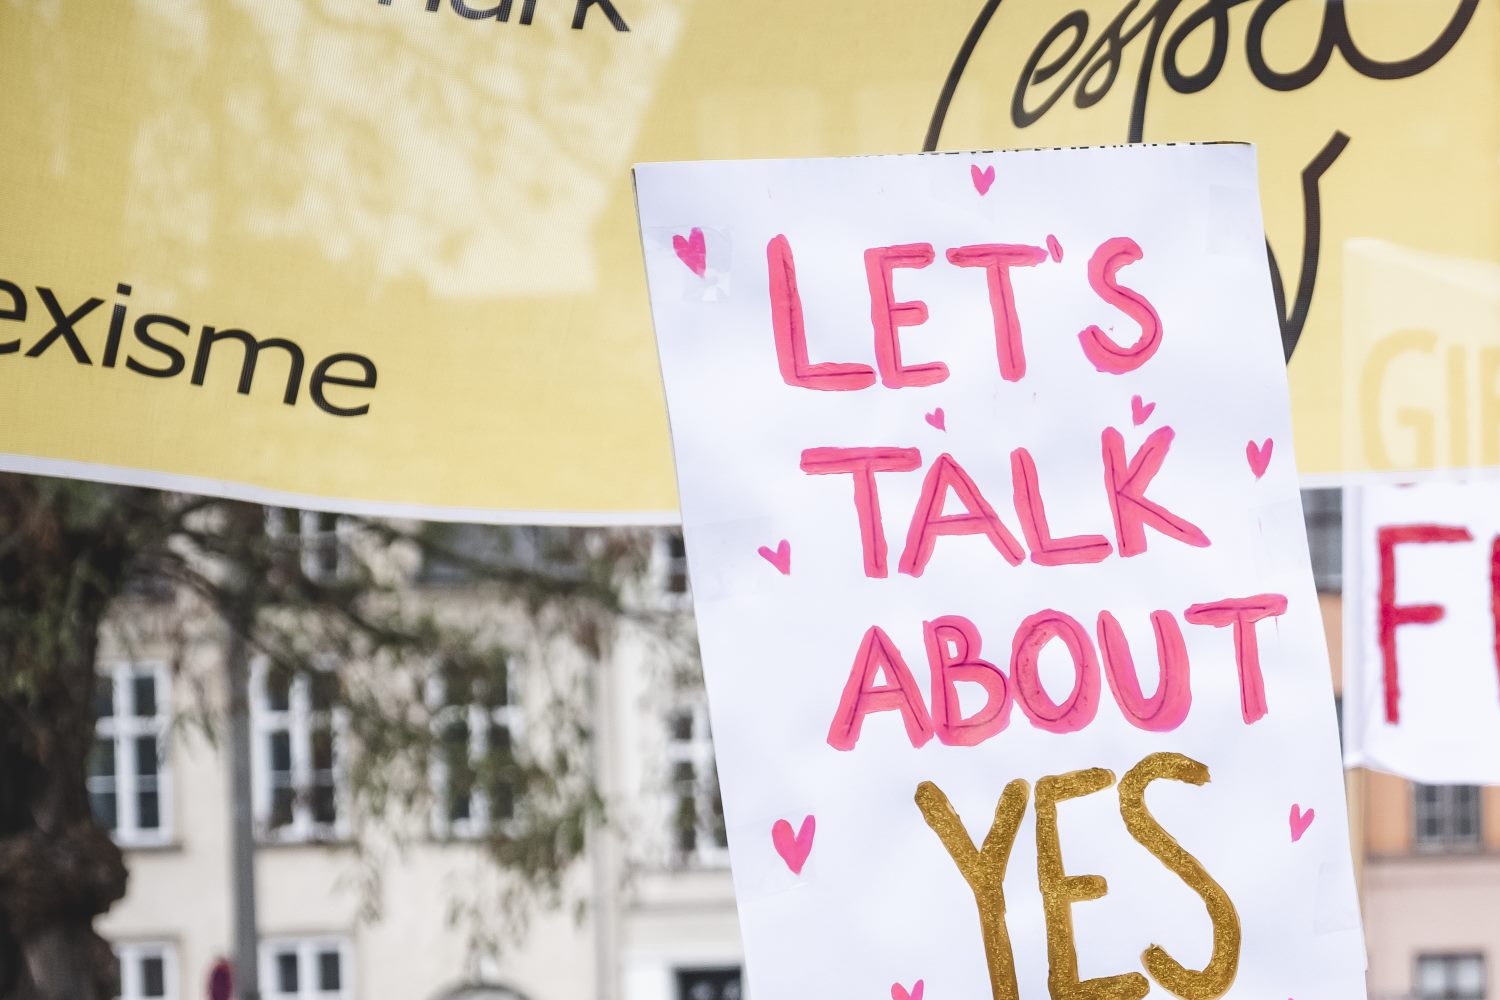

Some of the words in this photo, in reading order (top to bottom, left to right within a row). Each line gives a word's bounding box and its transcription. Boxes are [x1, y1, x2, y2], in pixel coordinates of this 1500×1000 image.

[766, 233, 1162, 391] LET'S
[800, 424, 1212, 579] TALK
[826, 593, 1289, 752] ABOUT
